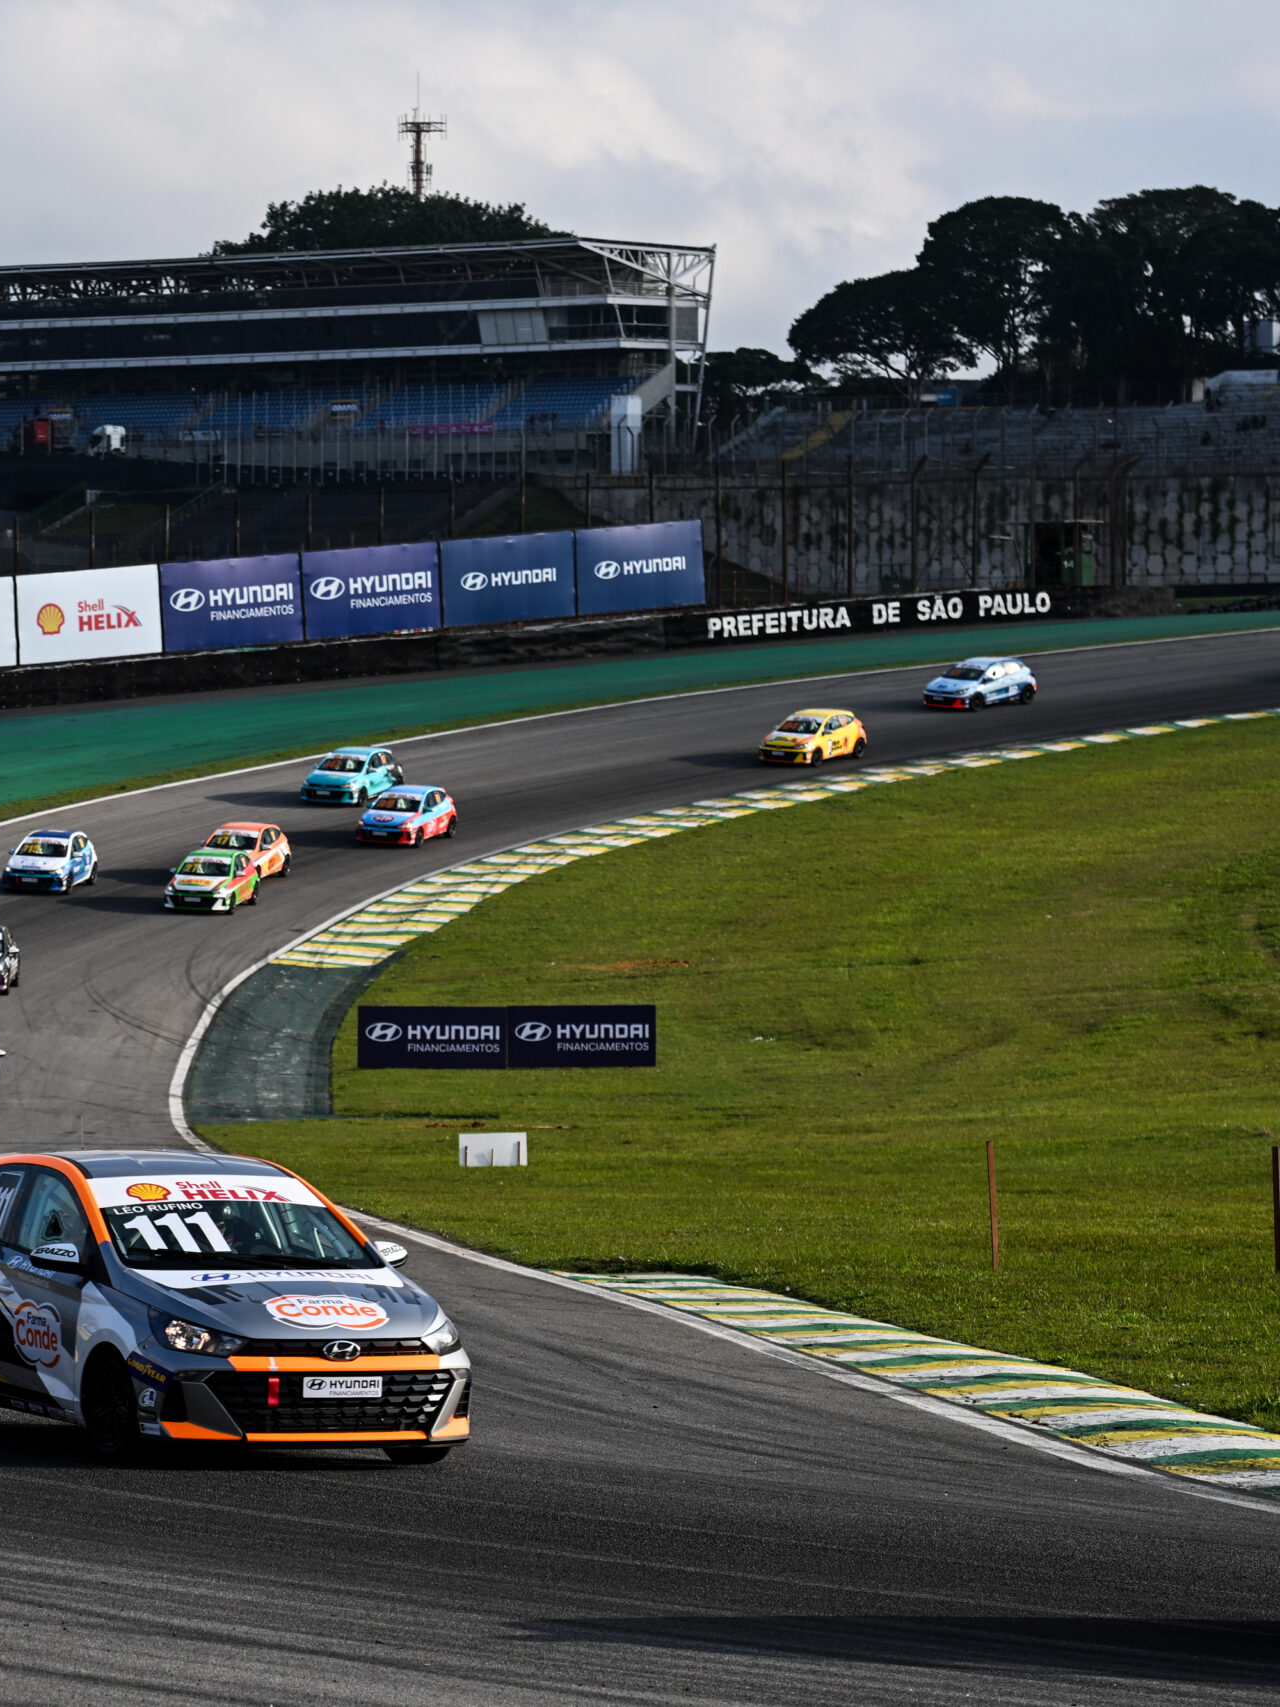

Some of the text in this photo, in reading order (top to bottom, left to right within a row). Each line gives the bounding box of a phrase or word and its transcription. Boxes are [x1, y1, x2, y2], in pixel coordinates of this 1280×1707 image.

[623, 555, 687, 575] HYUNDAI
[348, 570, 432, 595] HYUNDAI
[490, 567, 557, 588] HYUNDAI
[209, 582, 294, 607] HYUNDAI
[350, 592, 433, 609] FINANCIAMENTOS
[78, 599, 105, 613] Shell
[210, 603, 294, 621] FINANCIAMENTOS
[78, 606, 143, 633] HELIX
[707, 591, 1052, 639] PREFEITURA DE SÃO PAULO
[407, 1025, 500, 1040] HYUNDAI
[557, 1023, 650, 1039] HYUNDAI
[407, 1043, 500, 1053] FINANCIAMENTOS
[557, 1042, 649, 1051] FINANCIAMENTOS
[176, 1180, 221, 1189] Shell
[180, 1187, 289, 1202] HELIX
[113, 1202, 204, 1216] LÉO RUFINO
[123, 1211, 232, 1253] 111
[34, 1247, 77, 1258] BRAZZO
[245, 1271, 375, 1281] HYUNDAI
[296, 1297, 344, 1305] Farma
[275, 1303, 377, 1318] Conde
[26, 1311, 47, 1327] Farma
[16, 1318, 58, 1352] Conde
[329, 1379, 380, 1389] HYUNDAI
